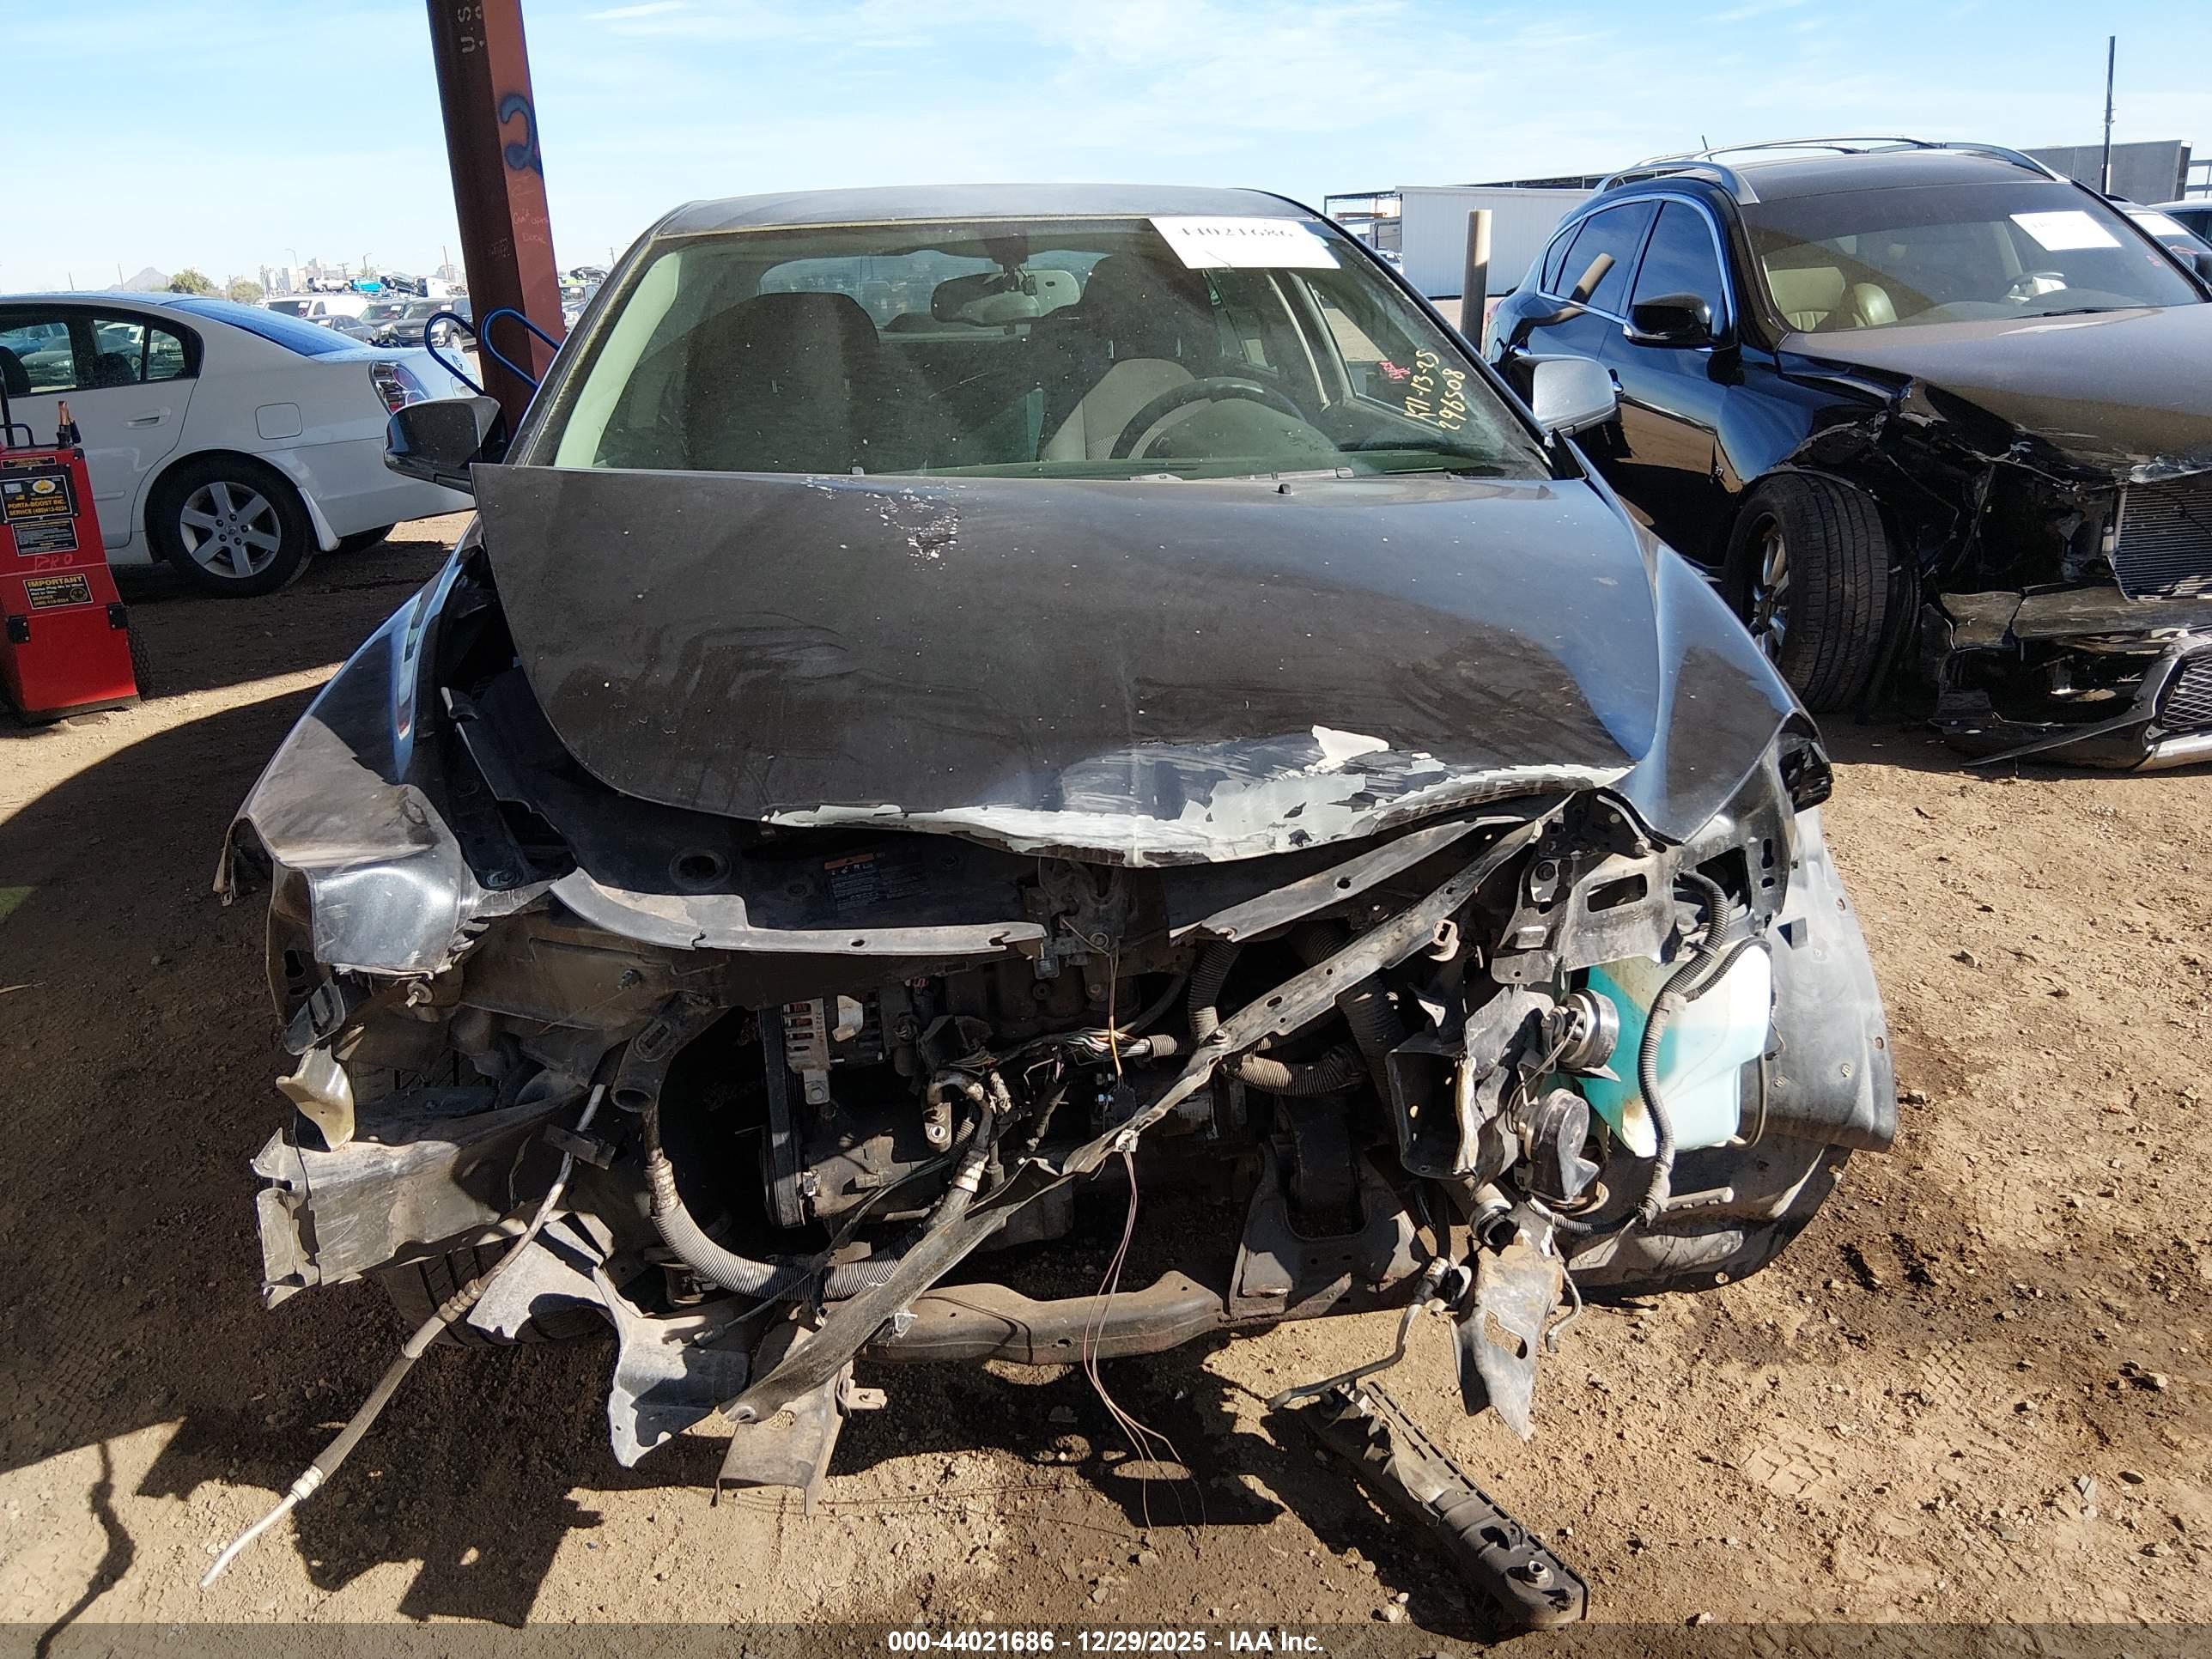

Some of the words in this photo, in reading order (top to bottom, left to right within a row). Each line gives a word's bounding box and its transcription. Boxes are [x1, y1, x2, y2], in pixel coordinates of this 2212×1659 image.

[500, 93, 543, 177] 2
[1438, 368, 1468, 430] 296508
[7, 500, 52, 510] PORTA-BOOST
[9, 507, 33, 516] SERVICE
[27, 575, 83, 588] IMPORTANT
